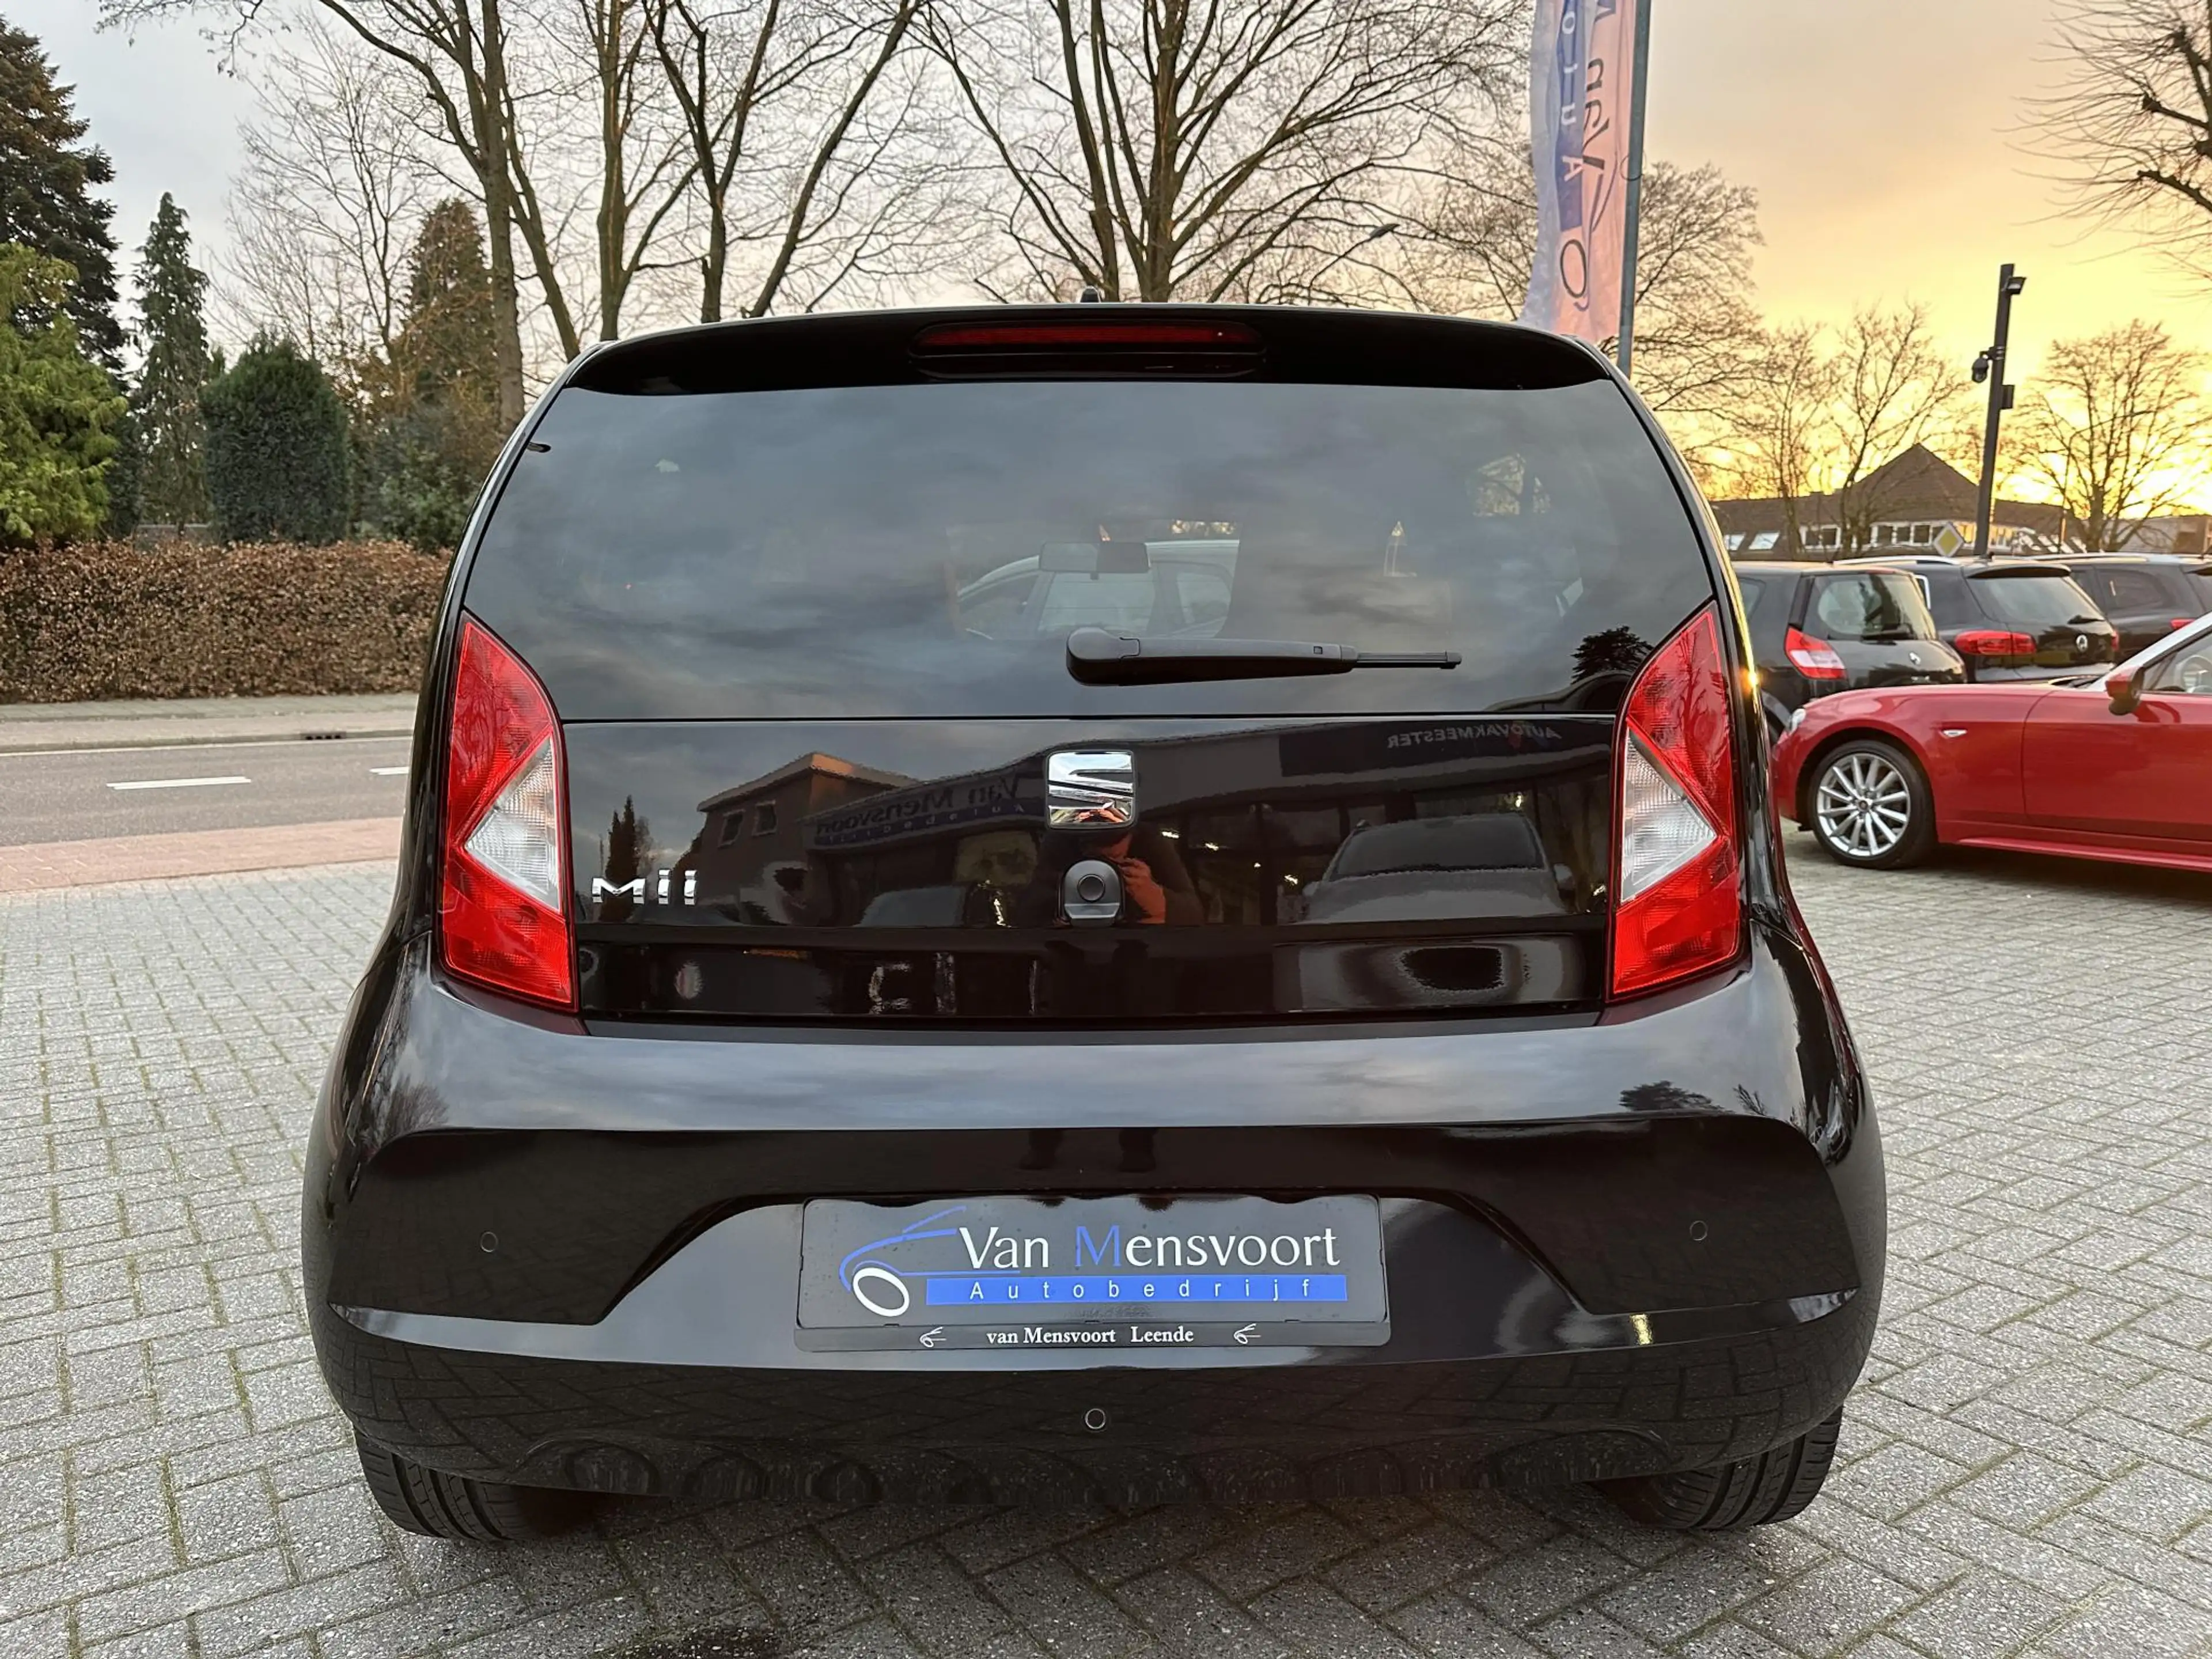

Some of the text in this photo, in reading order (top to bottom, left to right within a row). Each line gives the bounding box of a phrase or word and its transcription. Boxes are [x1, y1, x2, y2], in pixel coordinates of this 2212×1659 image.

[959, 1224, 1340, 1269] Van Mensvoort
[987, 1325, 1195, 1344] van Mensvoort Leende
